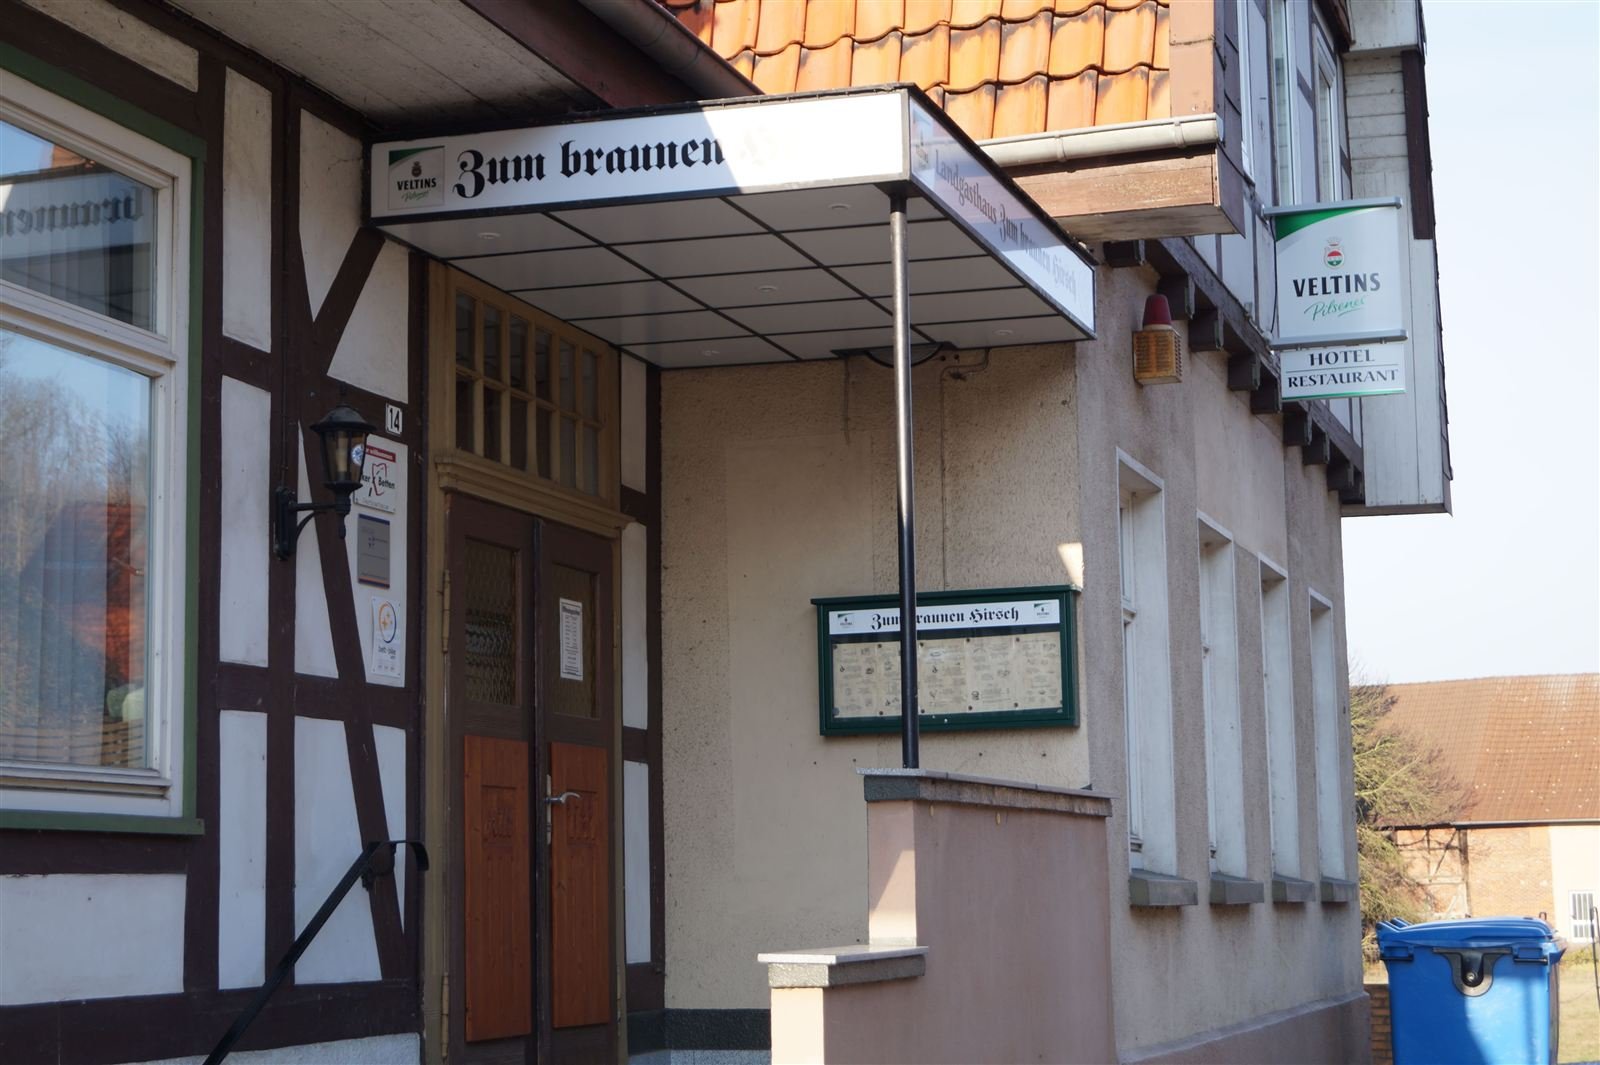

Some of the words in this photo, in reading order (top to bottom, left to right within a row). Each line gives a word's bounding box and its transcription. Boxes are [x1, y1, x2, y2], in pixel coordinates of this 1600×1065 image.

[452, 148, 546, 199] Zum
[560, 137, 726, 178] braunen
[396, 177, 437, 191] VELTINS
[935, 149, 998, 225] Landgasthaus
[999, 203, 1019, 245] Zum
[1292, 272, 1381, 298] VELTINS
[1309, 349, 1375, 367] HOTEL
[1287, 369, 1399, 388] RESTAURANT
[389, 407, 400, 432] 14
[916, 612, 965, 624] raunen
[969, 607, 1019, 624] Hirsch
